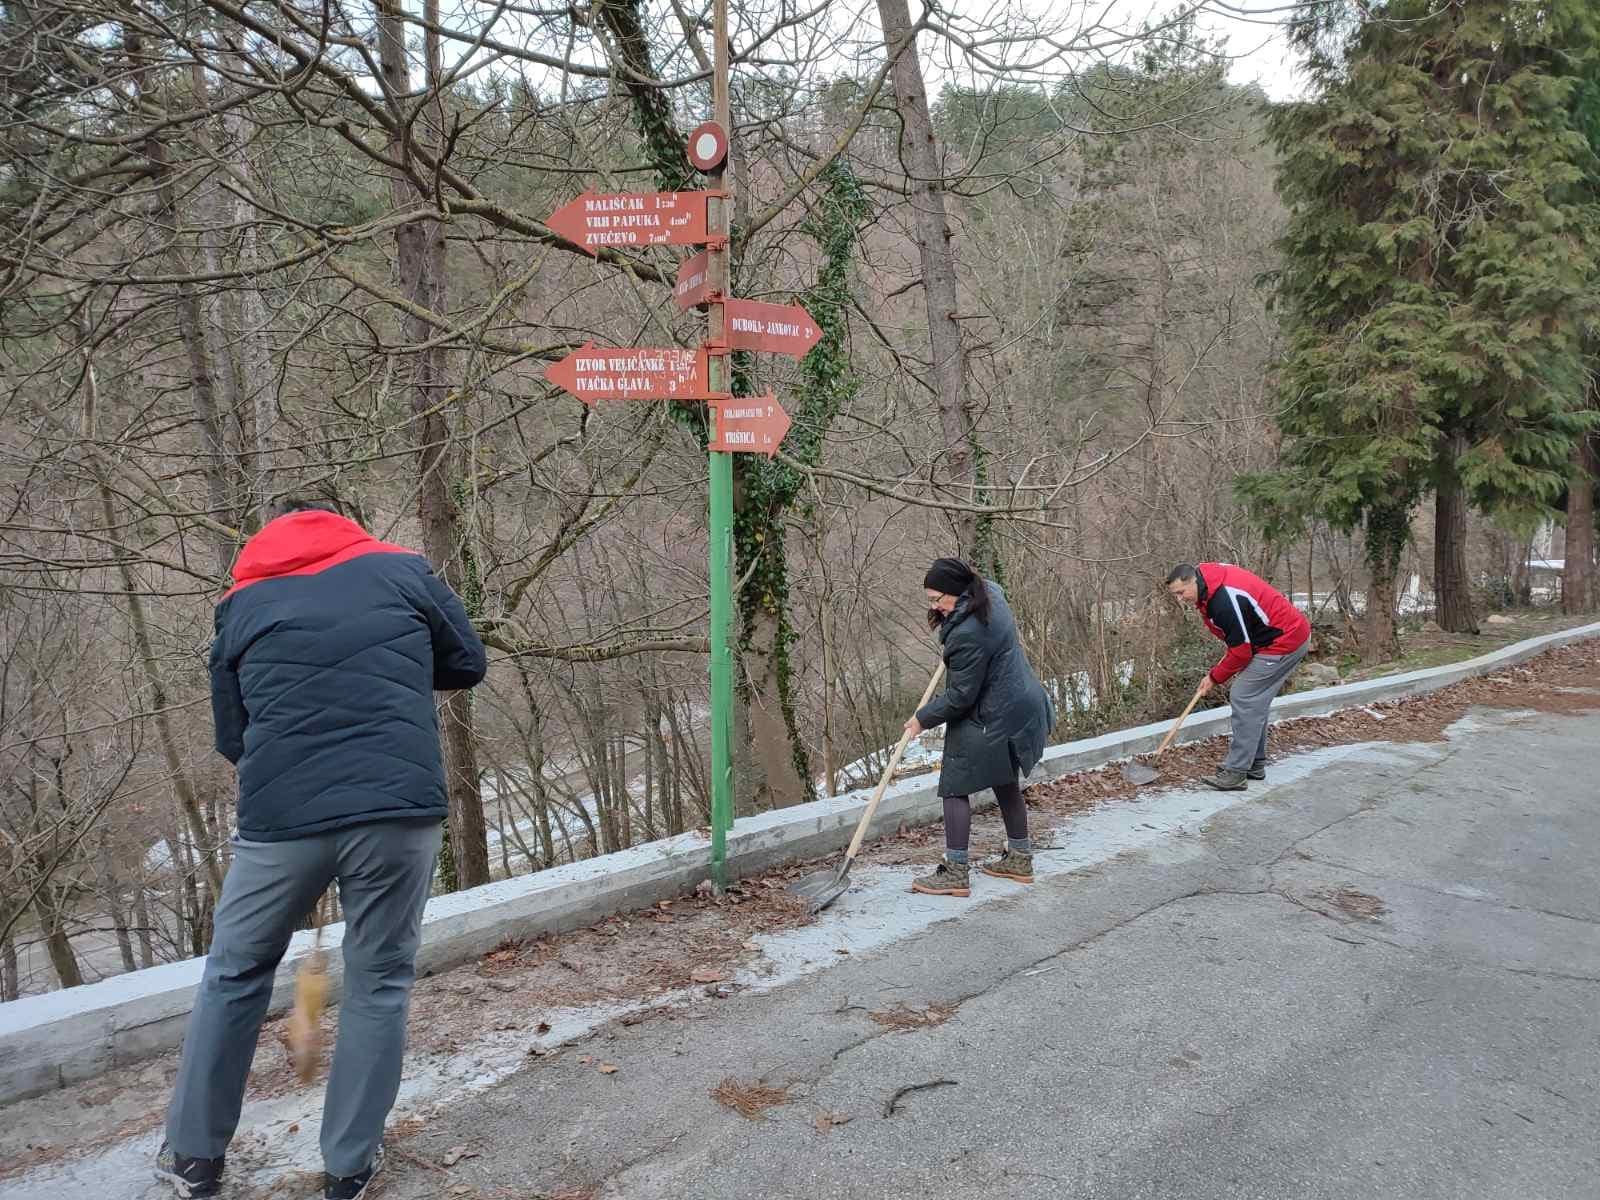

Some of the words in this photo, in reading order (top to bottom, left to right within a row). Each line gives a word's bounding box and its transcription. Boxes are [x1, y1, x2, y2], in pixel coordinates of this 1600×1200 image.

[585, 196, 644, 211] MALIŠČAK
[586, 216, 609, 228] VRH
[612, 213, 661, 227] PAPUKA
[585, 230, 637, 245] ZVEČEVO
[766, 321, 800, 337] JANKOVAC
[575, 358, 606, 372] IZVOR
[608, 355, 665, 371] VELIČANKE
[576, 375, 614, 391] IVAČKA
[617, 376, 651, 391] GLAVA
